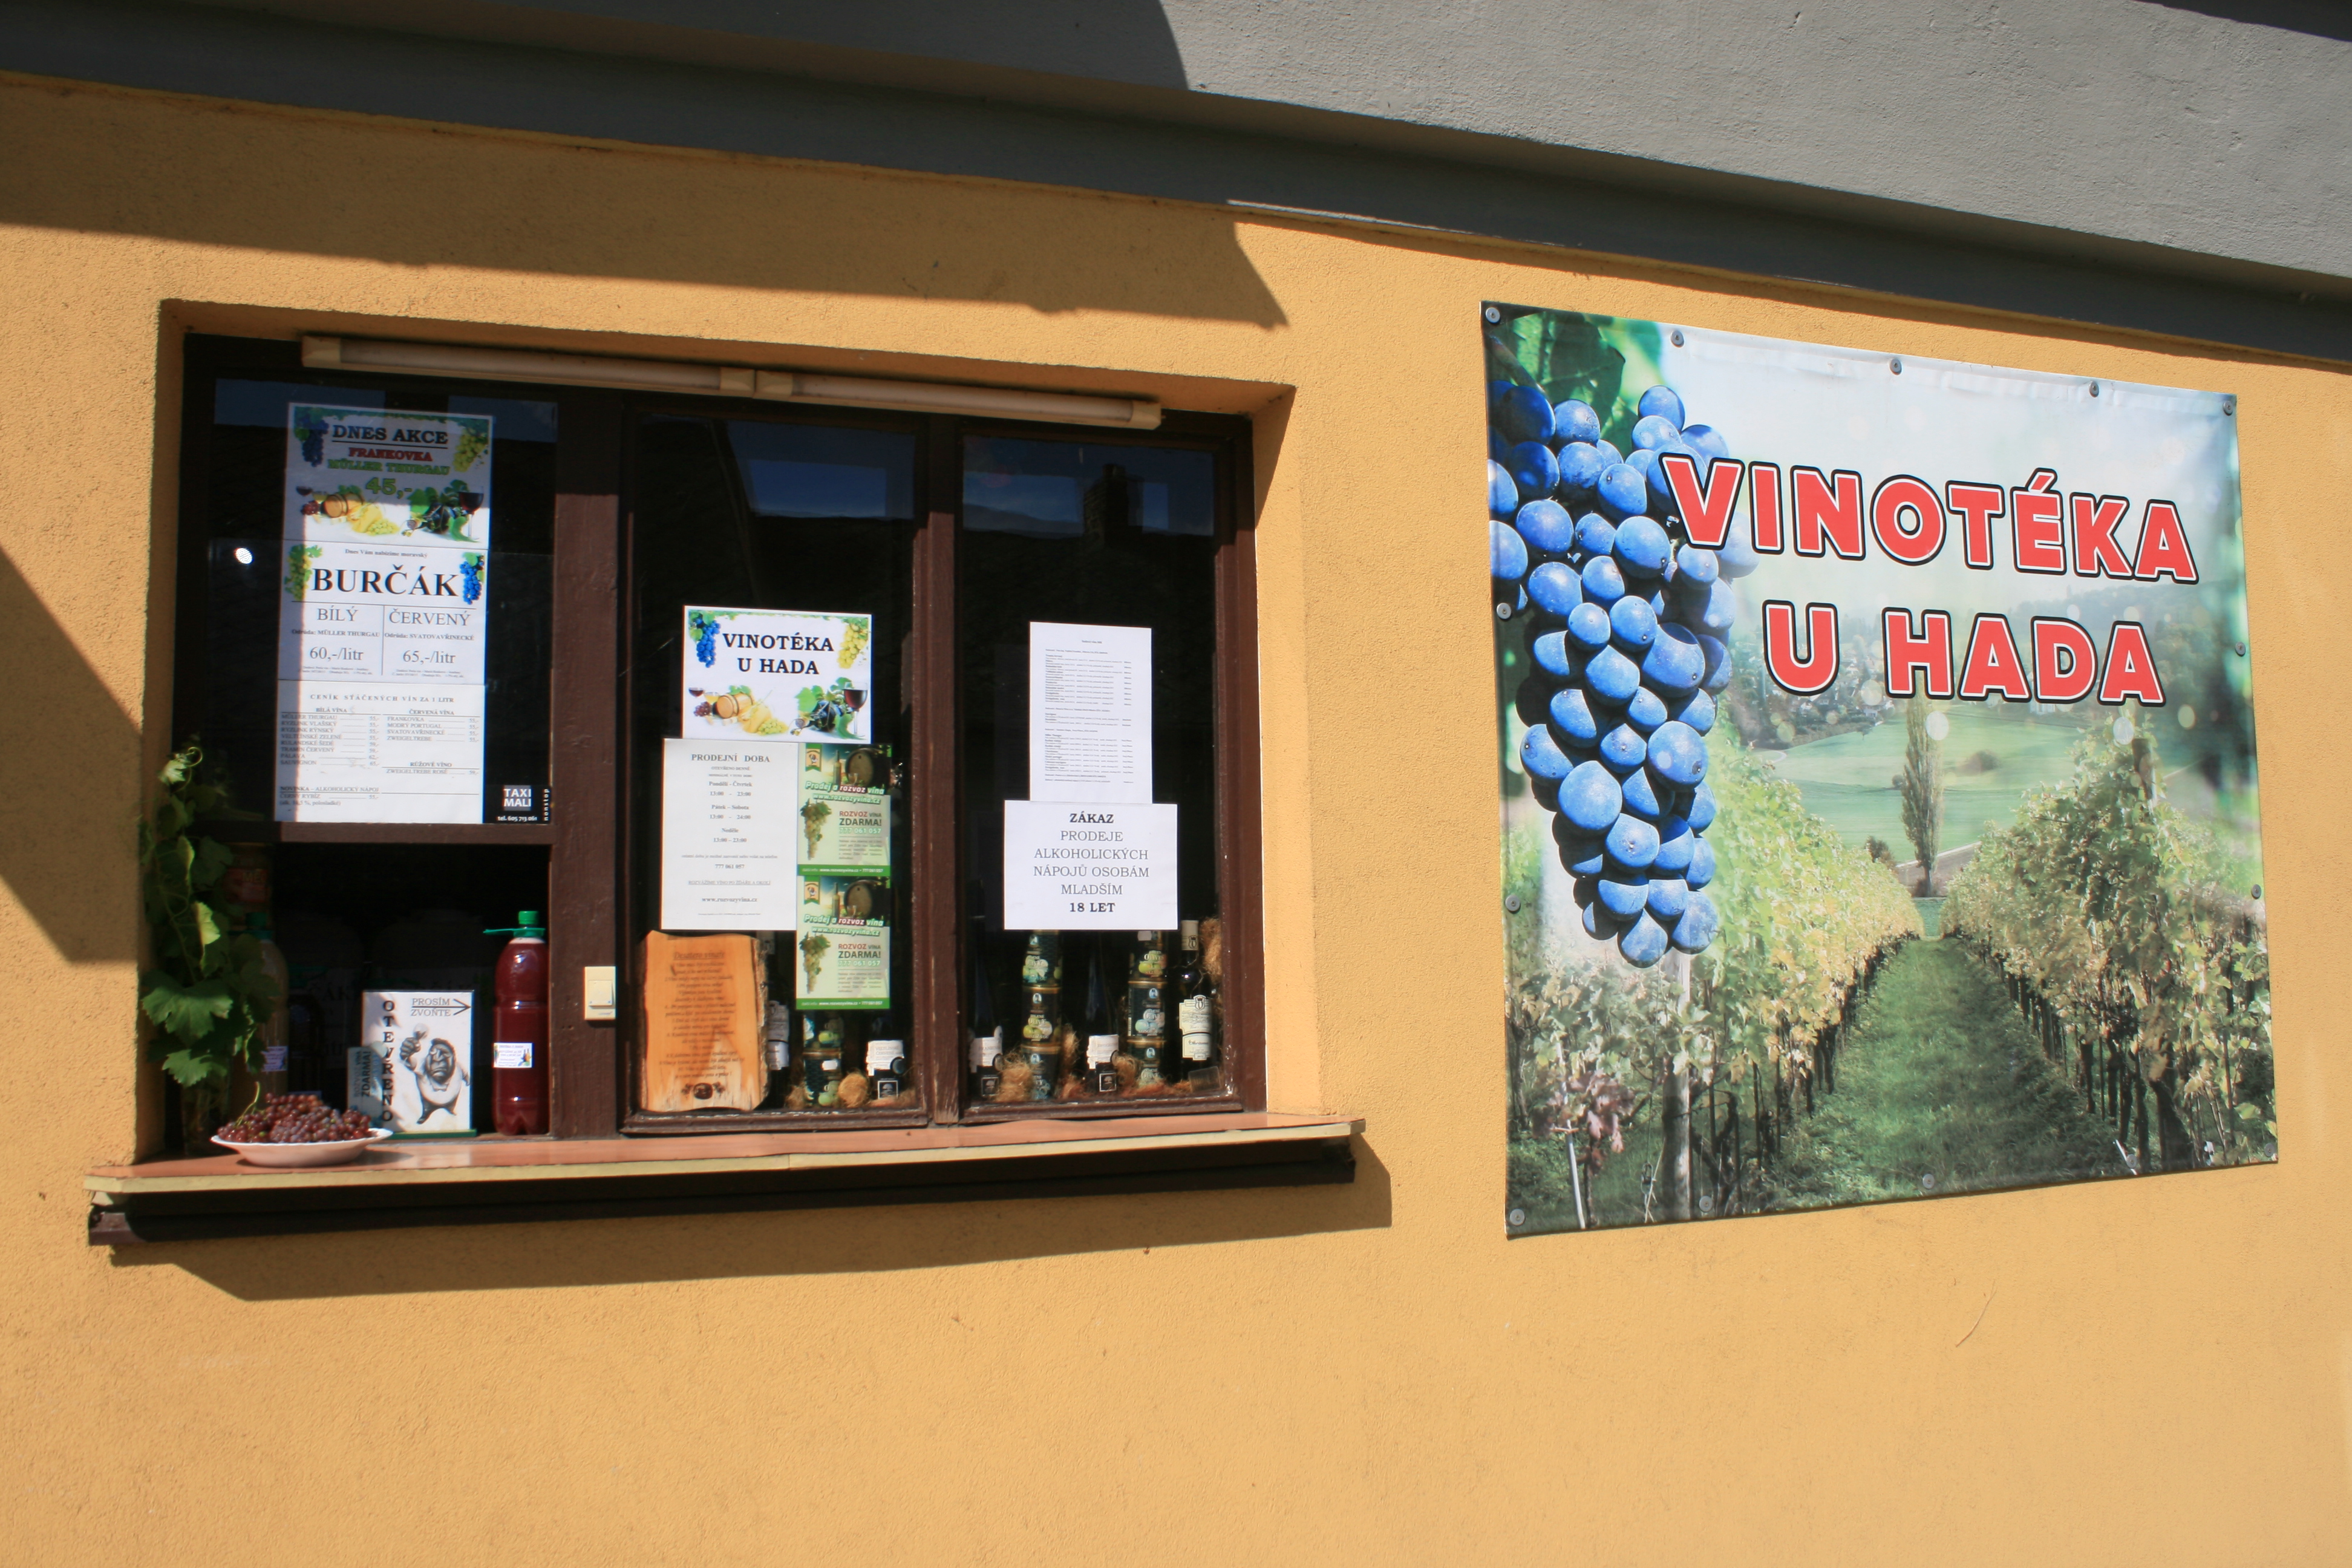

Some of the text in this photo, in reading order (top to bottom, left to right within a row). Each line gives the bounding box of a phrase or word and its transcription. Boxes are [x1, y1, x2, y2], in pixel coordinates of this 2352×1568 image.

[333, 425, 448, 444] DNES AKCE
[348, 447, 433, 462] FRANKOVKA
[327, 457, 451, 475] MÜLLER THURGAU
[365, 477, 413, 499] 45,-
[1658, 452, 2199, 584] VINOTÉKA
[311, 564, 459, 596] BURČÁK
[317, 605, 358, 621] BÍLÝ
[389, 608, 471, 626] ČERVENÝ
[723, 632, 834, 652] VINOTÉKA
[310, 647, 364, 661] 60,-/litr
[402, 650, 456, 665] 65,-/litr
[1762, 599, 2166, 707] U HADA
[737, 658, 819, 675] U HADA
[691, 753, 737, 762] PRODEJNÍ
[805, 781, 832, 792] Prodej
[1070, 811, 1114, 823] ZÁKAZ
[1061, 831, 1123, 841] PRODEJE
[1034, 848, 1149, 860] ALKOHOLICKÝCH
[1033, 864, 1149, 877] NÁPOJŮ OSOBÁM
[1061, 883, 1123, 895] MLADŠÍM
[1070, 903, 1116, 913] 18 LET
[805, 913, 831, 924] Prodej
[413, 997, 450, 1005] PROSÍM
[362, 1051, 371, 1097] ZDARMA!
